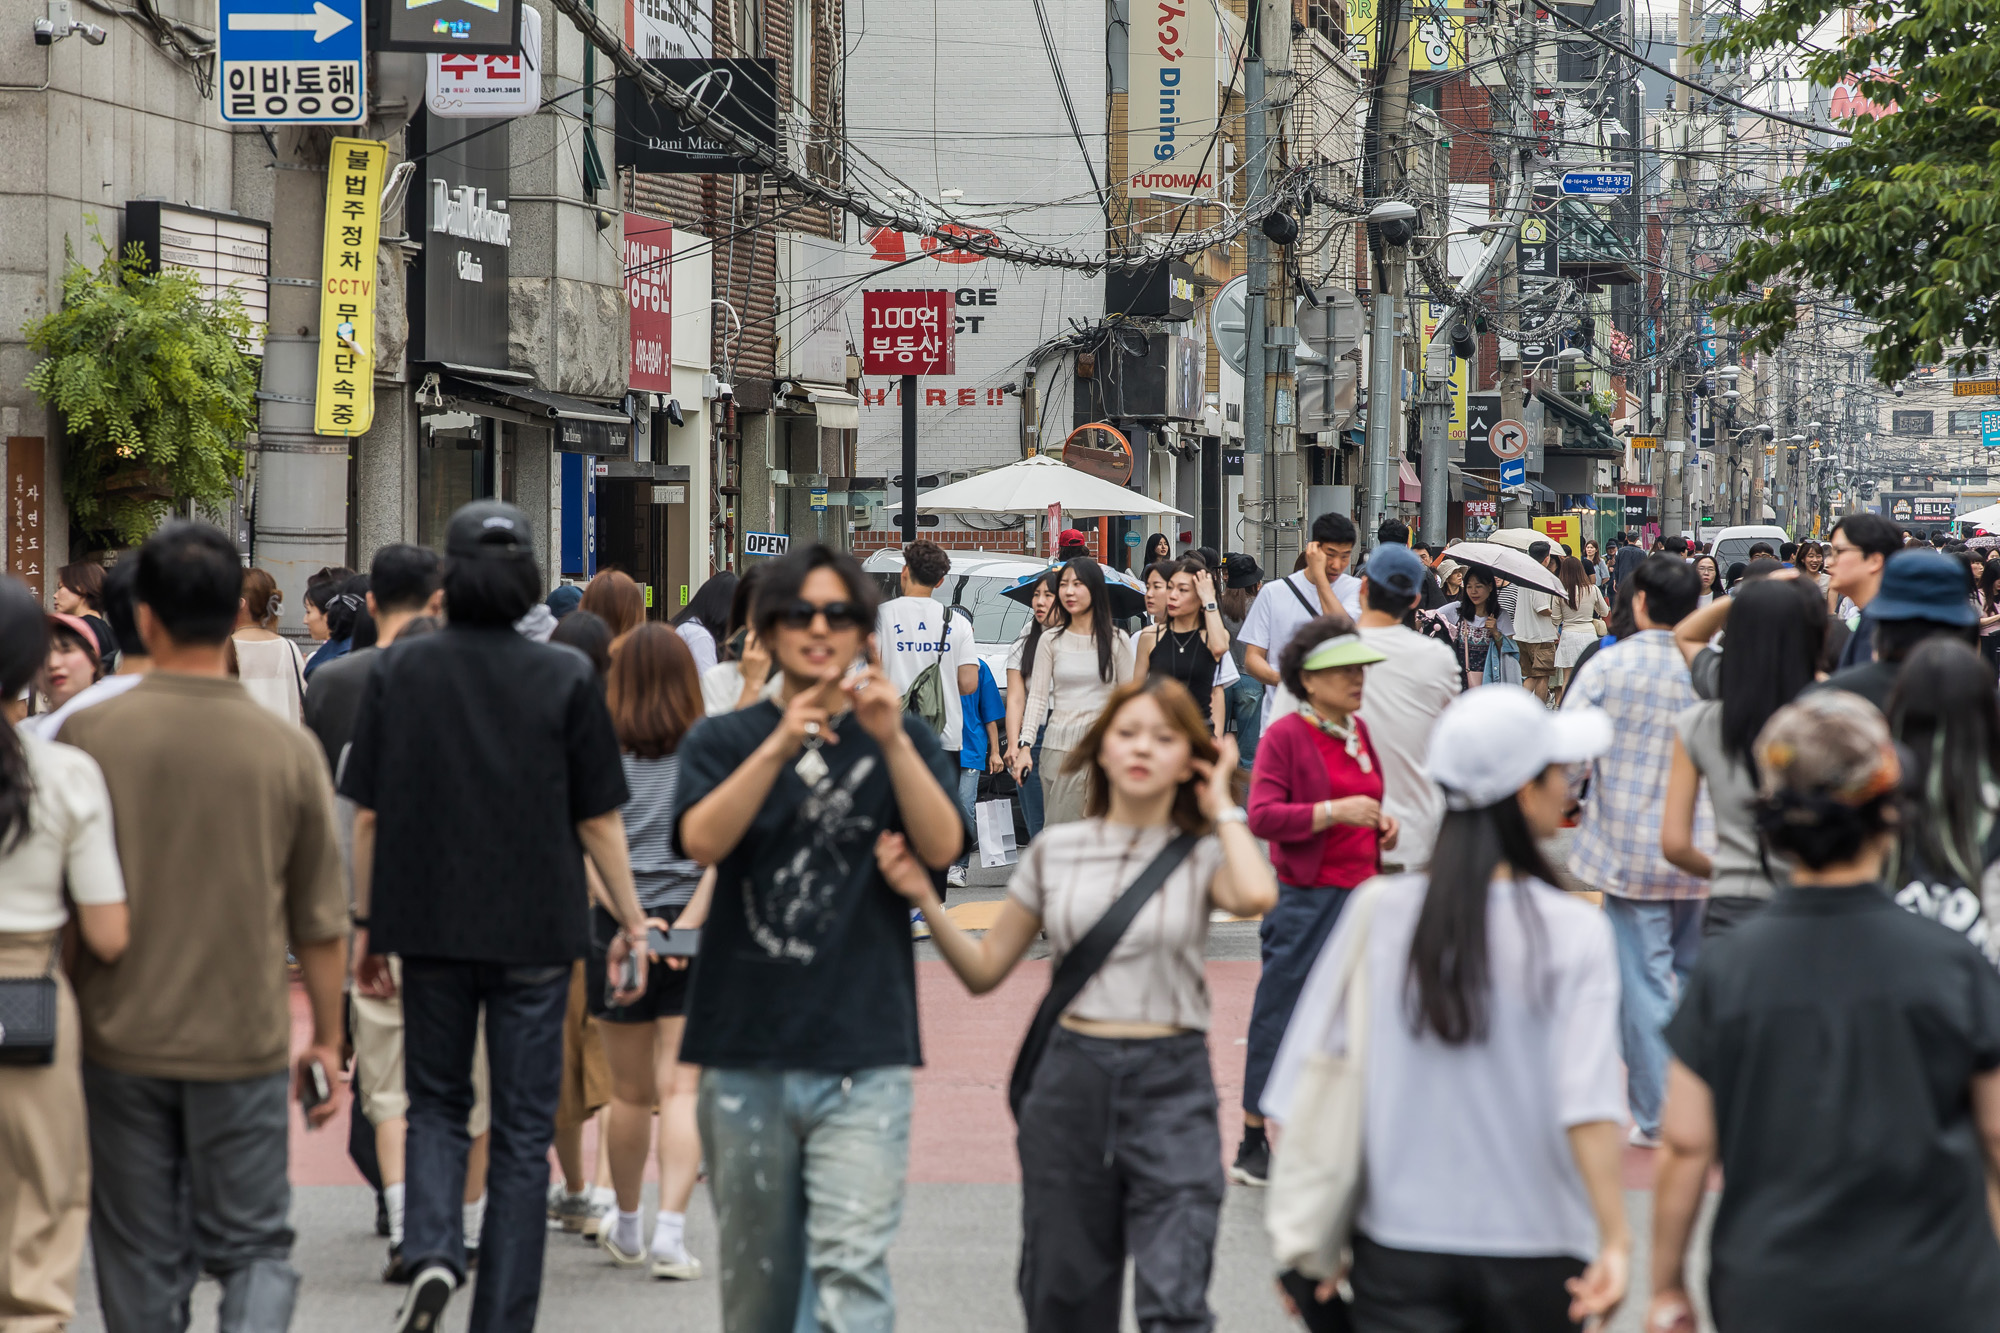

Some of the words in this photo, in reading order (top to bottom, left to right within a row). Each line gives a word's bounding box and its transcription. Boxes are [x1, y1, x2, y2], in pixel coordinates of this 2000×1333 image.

[229, 65, 355, 116] 일방통행
[1154, 67, 1181, 161] Dining
[1132, 174, 1212, 189] FUTOMAKI
[1596, 176, 1630, 186] 연무장길
[340, 149, 371, 272] 불법주정차
[328, 278, 371, 297] CCTV
[871, 306, 939, 333] 100억
[869, 335, 943, 363] 부동산
[1466, 502, 1497, 513] 옛날우동
[747, 534, 787, 555] OPEN
[896, 641, 951, 652] STUDIO
